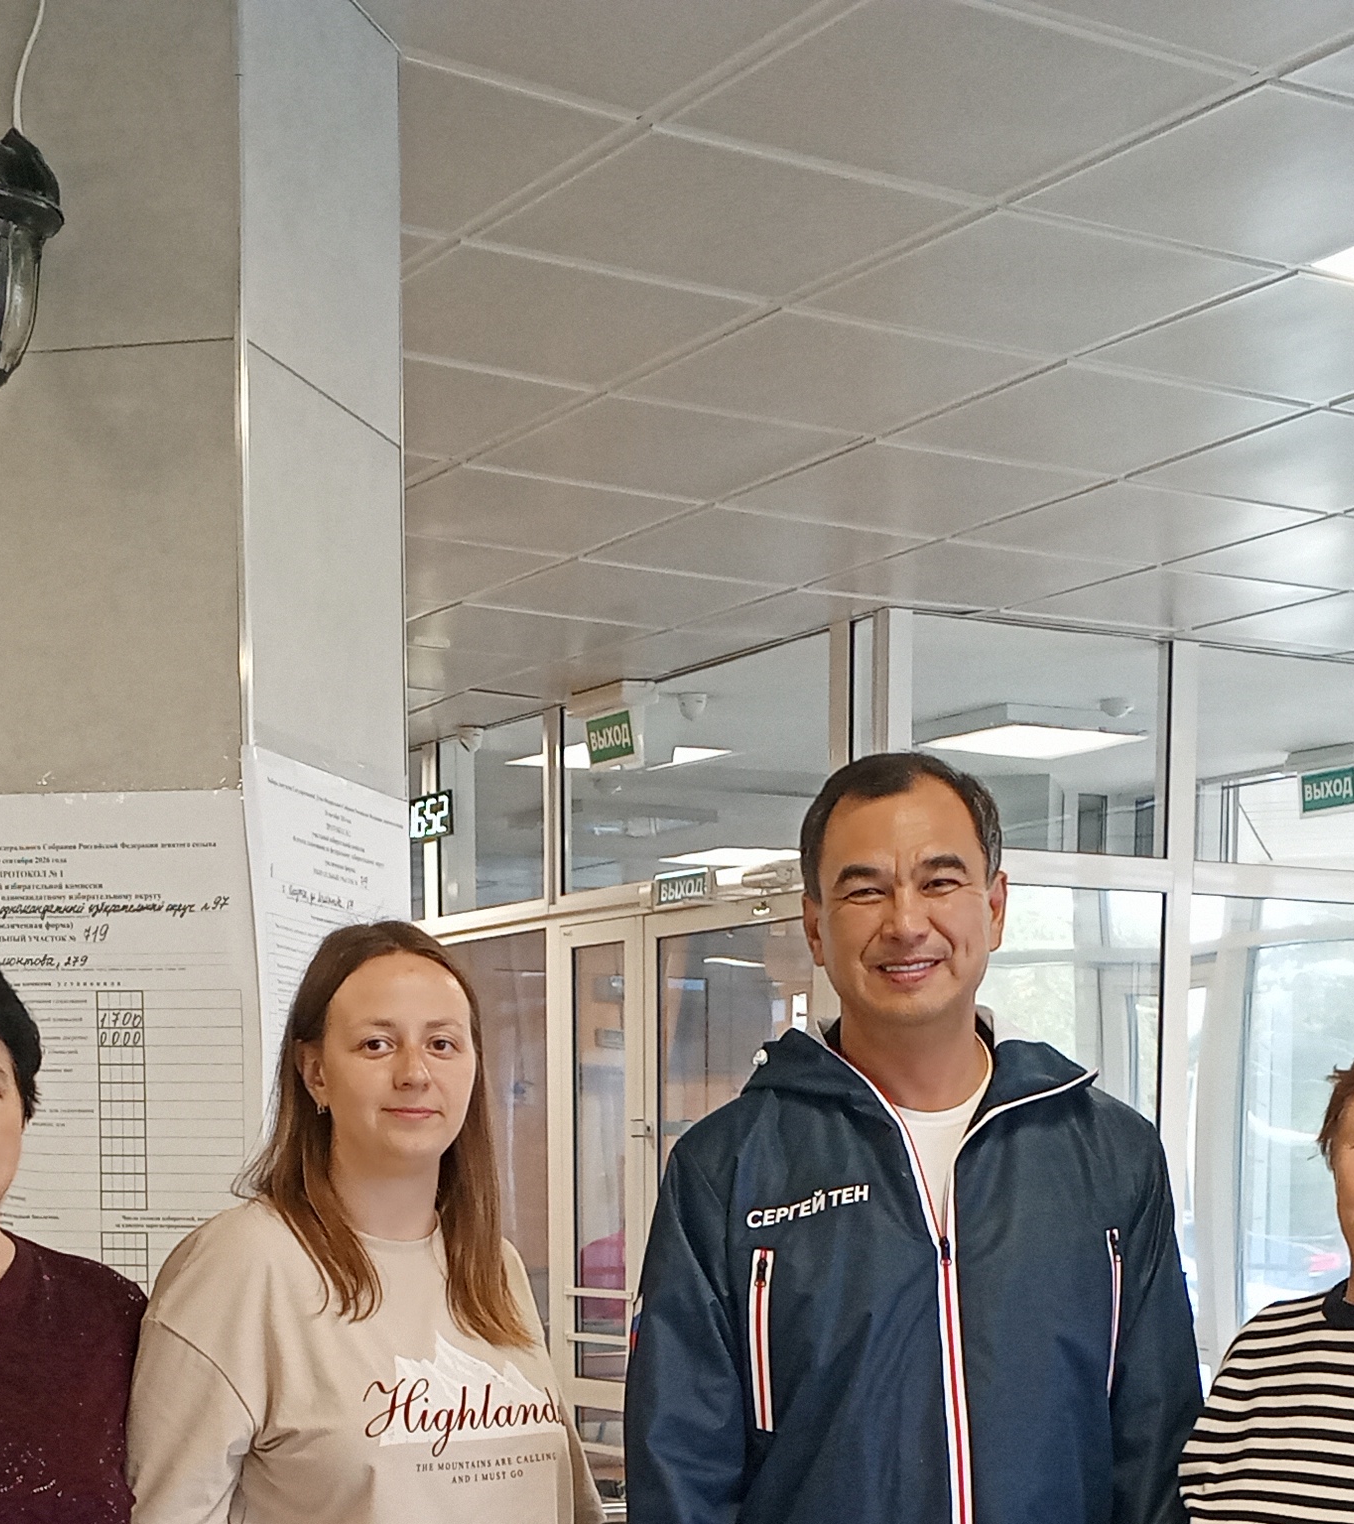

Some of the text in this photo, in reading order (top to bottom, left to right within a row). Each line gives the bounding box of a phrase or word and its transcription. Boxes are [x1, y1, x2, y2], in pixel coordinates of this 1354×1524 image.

[589, 723, 631, 752] ВЫХОД
[1304, 777, 1354, 802] ВЫХОД
[660, 878, 705, 902] ВЫХОД
[28, 935, 67, 943] УЧАСТОК
[83, 923, 109, 943] 719
[64, 955, 88, 967] 279
[746, 1184, 869, 1229] СЕРГЕЙ ТЕН
[416, 1463, 434, 1472] THE
[438, 1459, 492, 1472] MOUNTAINS
[495, 1456, 512, 1467] ARE
[451, 1474, 471, 1484] AND
[481, 1470, 506, 1482] MUST
[510, 1469, 524, 1479] GO
